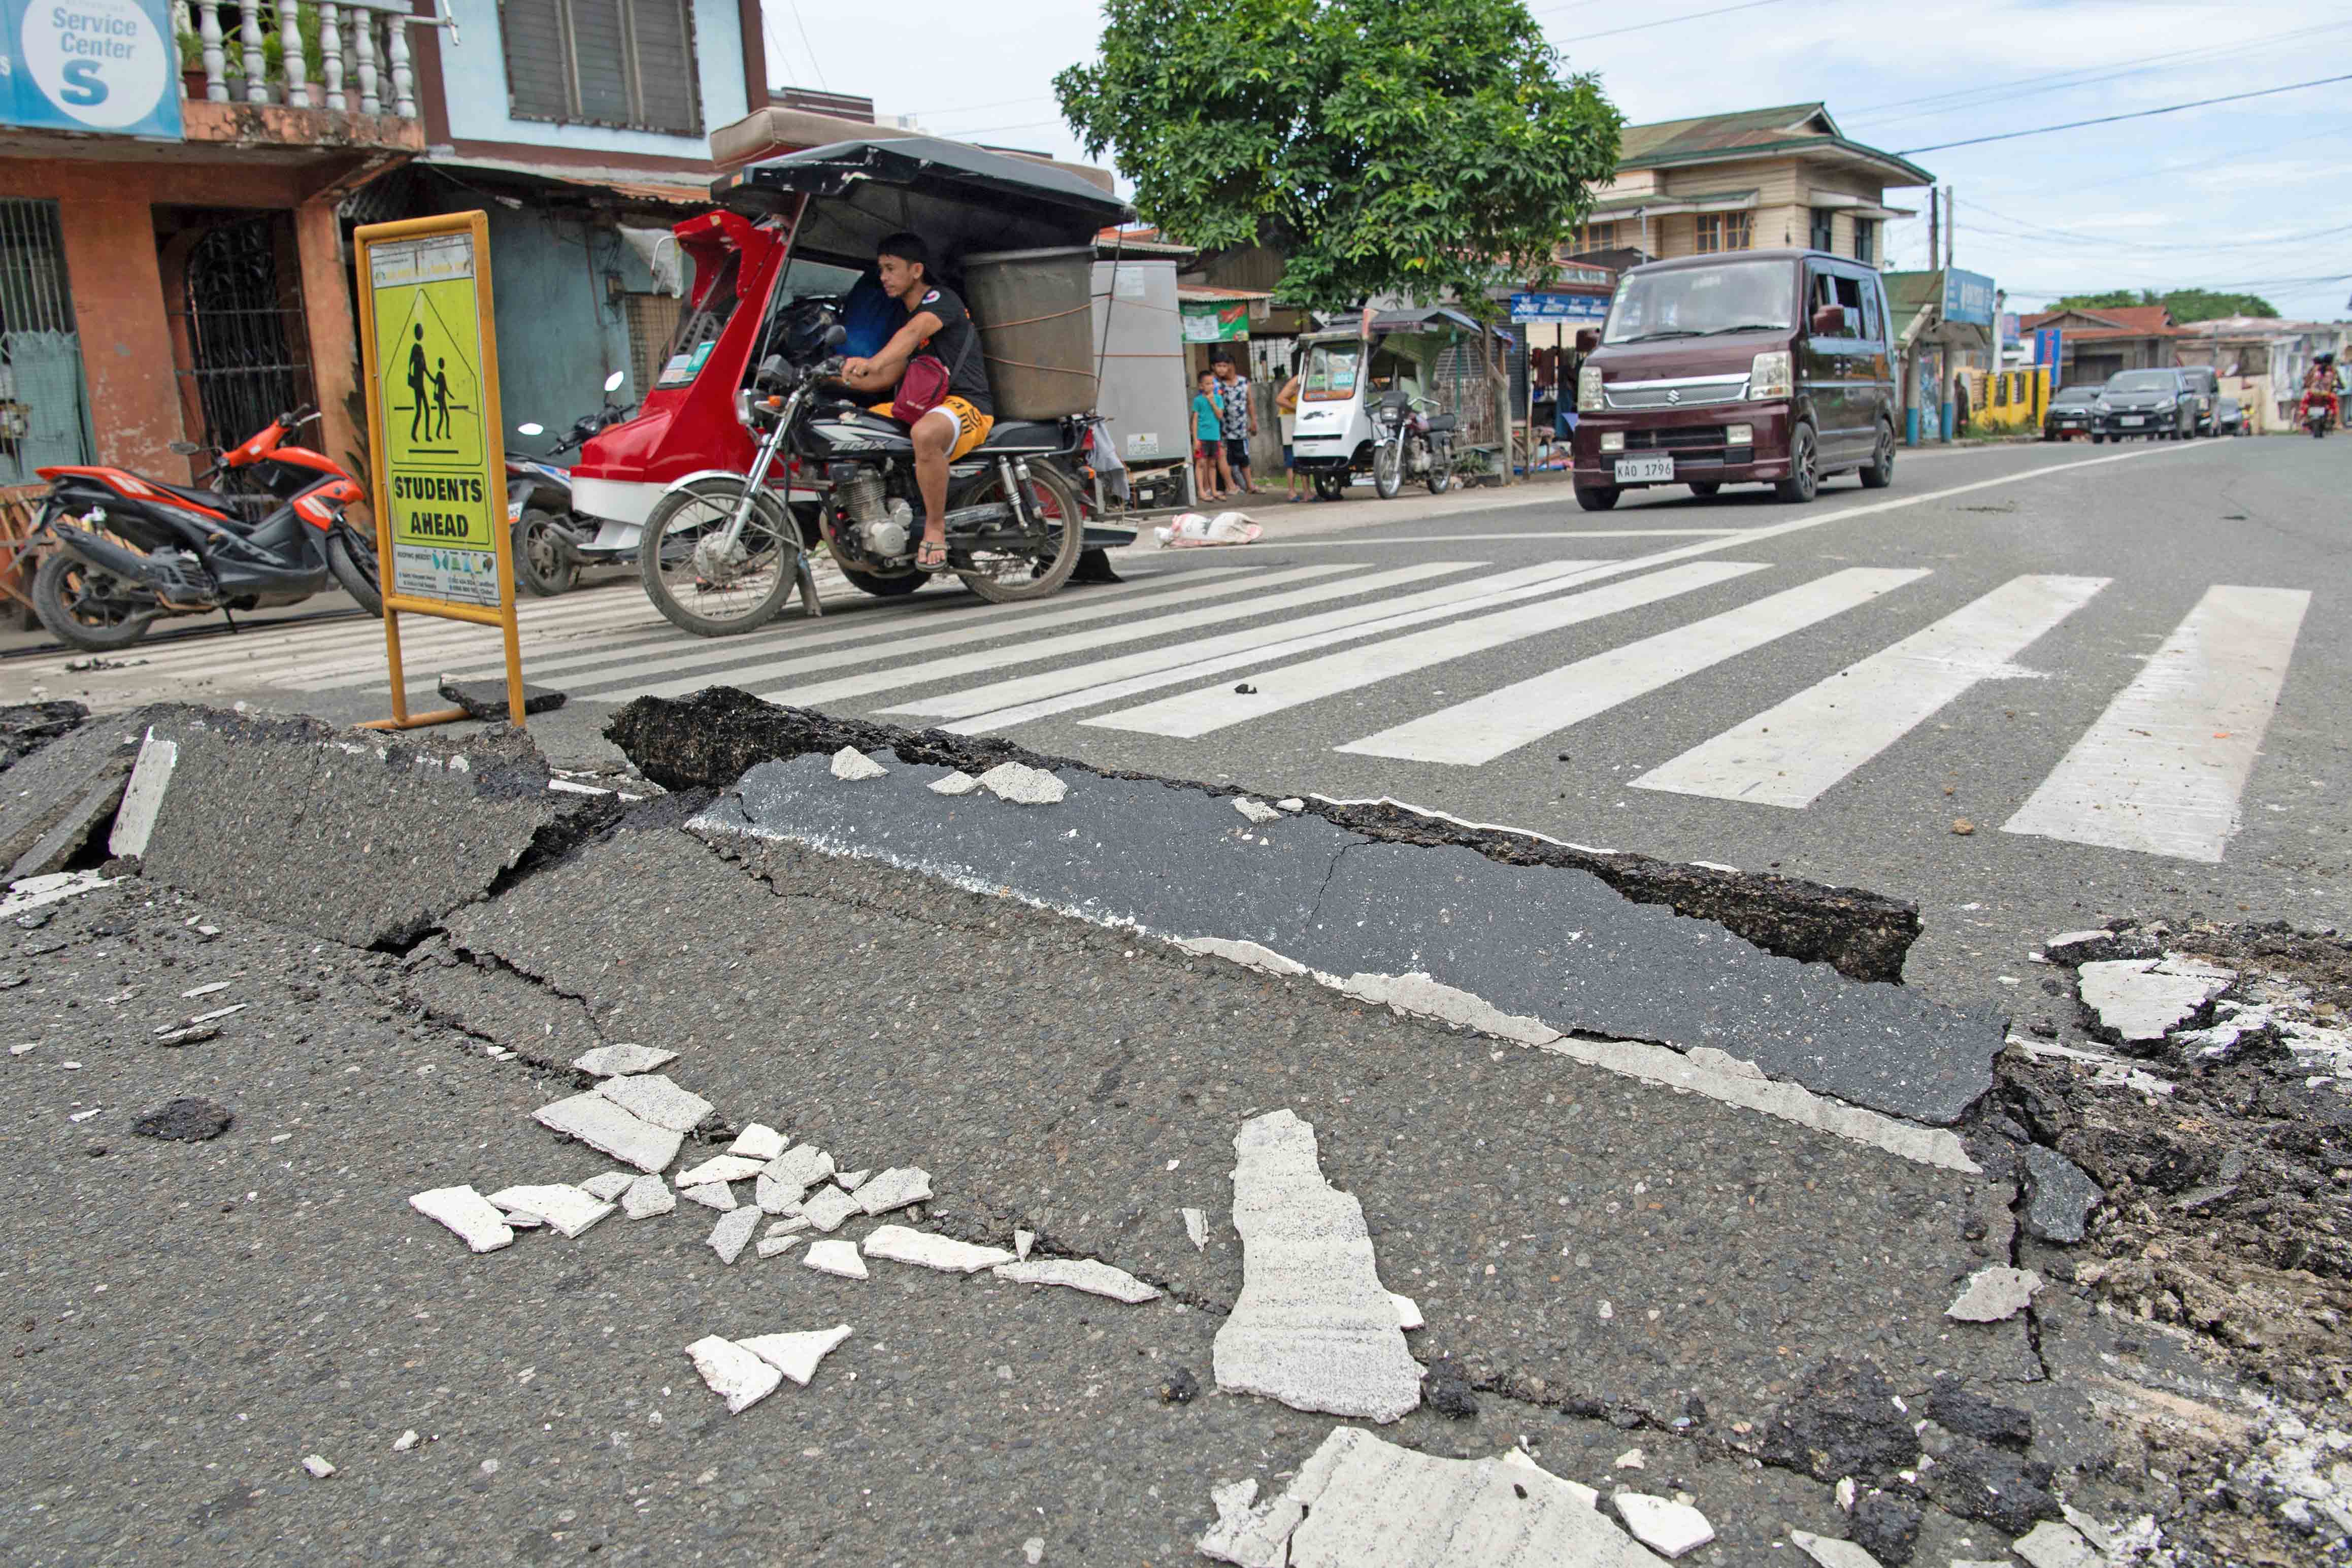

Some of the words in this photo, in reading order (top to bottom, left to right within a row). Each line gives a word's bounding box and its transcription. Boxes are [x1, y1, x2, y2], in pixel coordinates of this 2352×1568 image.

[52, 7, 137, 36] Service
[60, 31, 136, 59] Center
[59, 59, 109, 107] S
[829, 440, 888, 451] TMX
[1644, 462, 1671, 477] 1796
[394, 476, 482, 503] STUDENTS
[411, 512, 469, 537] AHEAD
